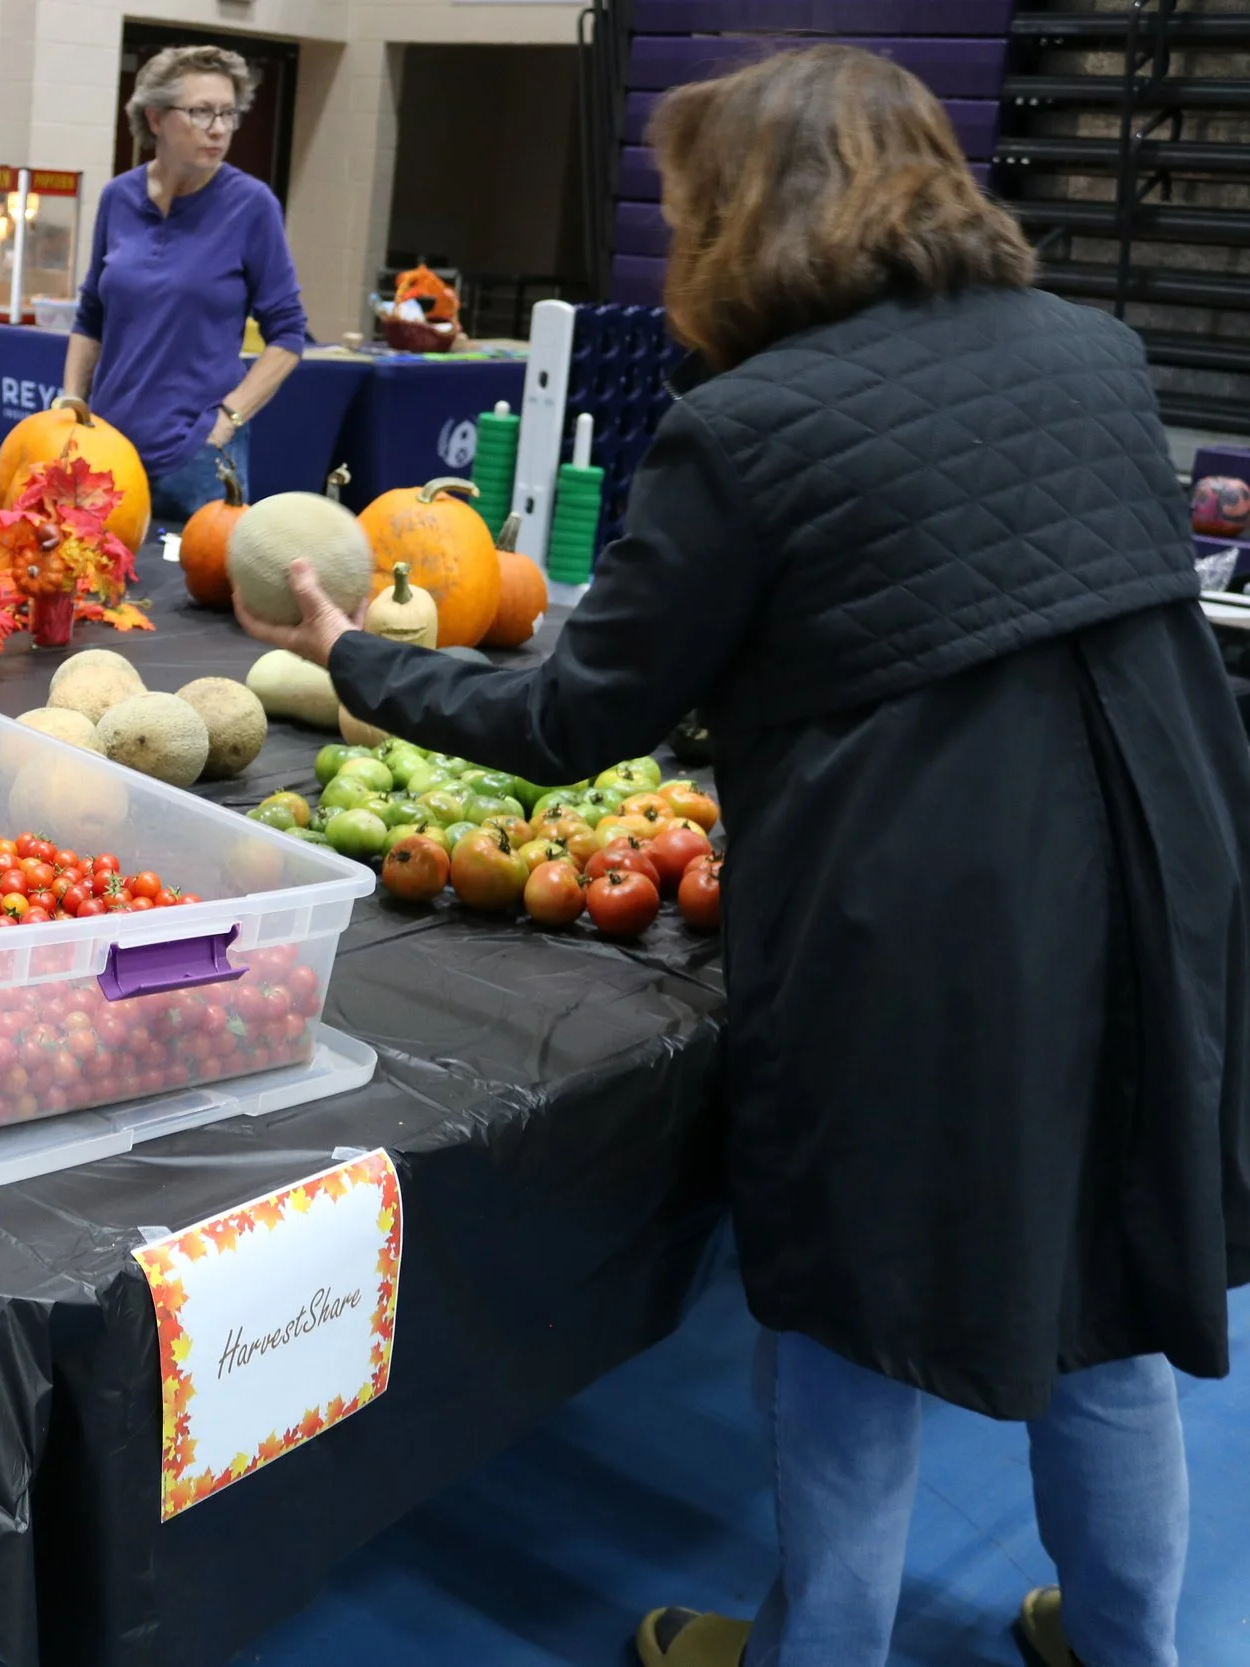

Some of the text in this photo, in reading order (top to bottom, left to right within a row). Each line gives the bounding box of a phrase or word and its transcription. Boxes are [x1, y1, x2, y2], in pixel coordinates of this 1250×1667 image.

[33, 173, 75, 190] POPCORN
[1, 376, 64, 412] REY
[218, 1286, 361, 1380] HarvestShare
